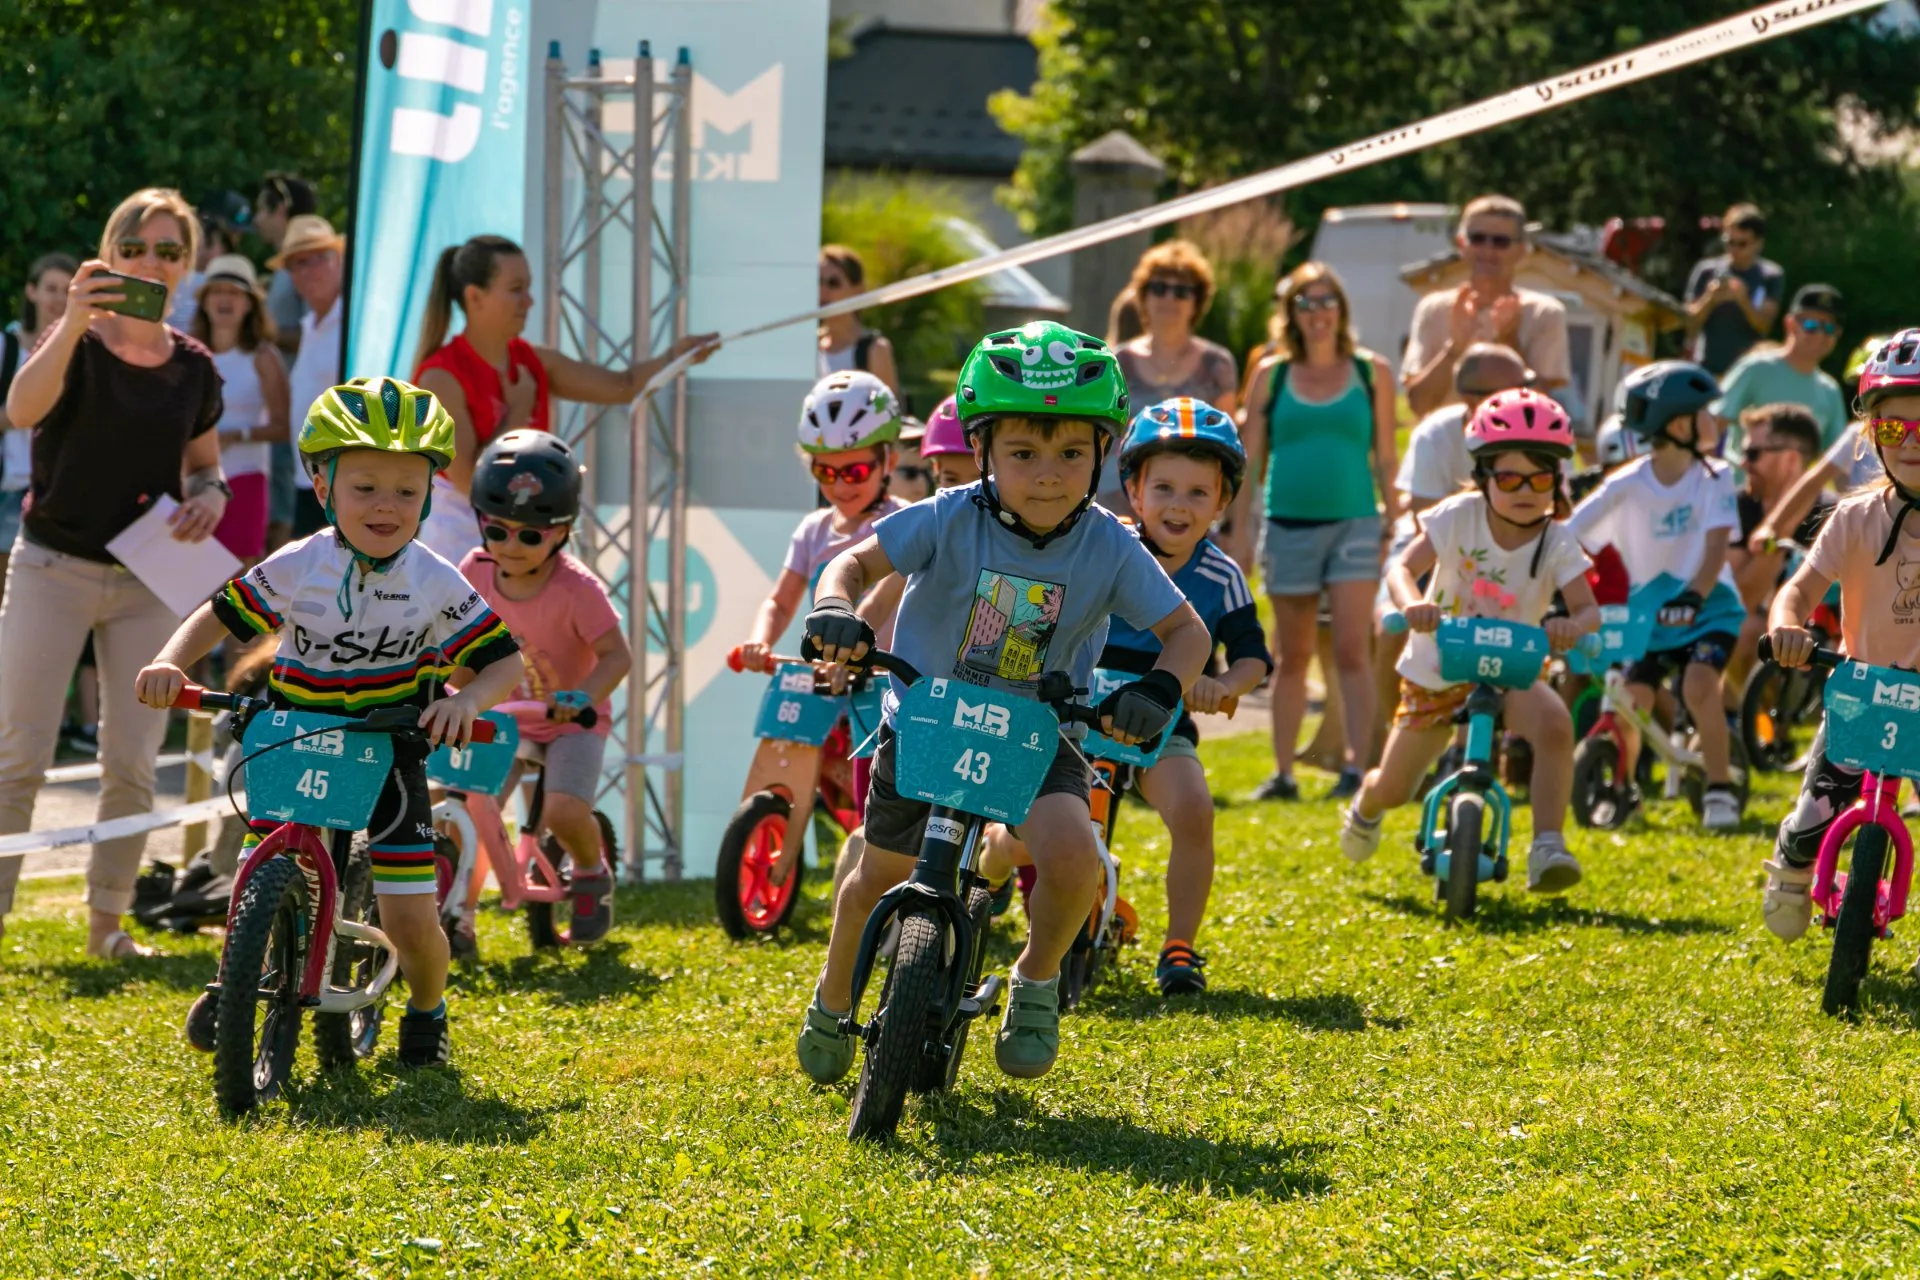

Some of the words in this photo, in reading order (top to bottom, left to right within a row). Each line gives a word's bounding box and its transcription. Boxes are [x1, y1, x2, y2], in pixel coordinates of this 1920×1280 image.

[1558, 59, 1634, 89] SCOTT
[294, 624, 430, 664] G-Skin
[1474, 625, 1513, 648] MB
[955, 660, 991, 685] SUMMER
[1477, 656, 1503, 678] 53
[777, 701, 802, 724] 66
[952, 696, 1011, 738] MB
[292, 723, 346, 757] MB
[964, 720, 997, 736] RACE
[1881, 720, 1898, 750] 3
[303, 745, 333, 756] RACE
[1021, 742, 1044, 752] SCOTT
[953, 748, 991, 785] 43
[295, 768, 330, 800] 45
